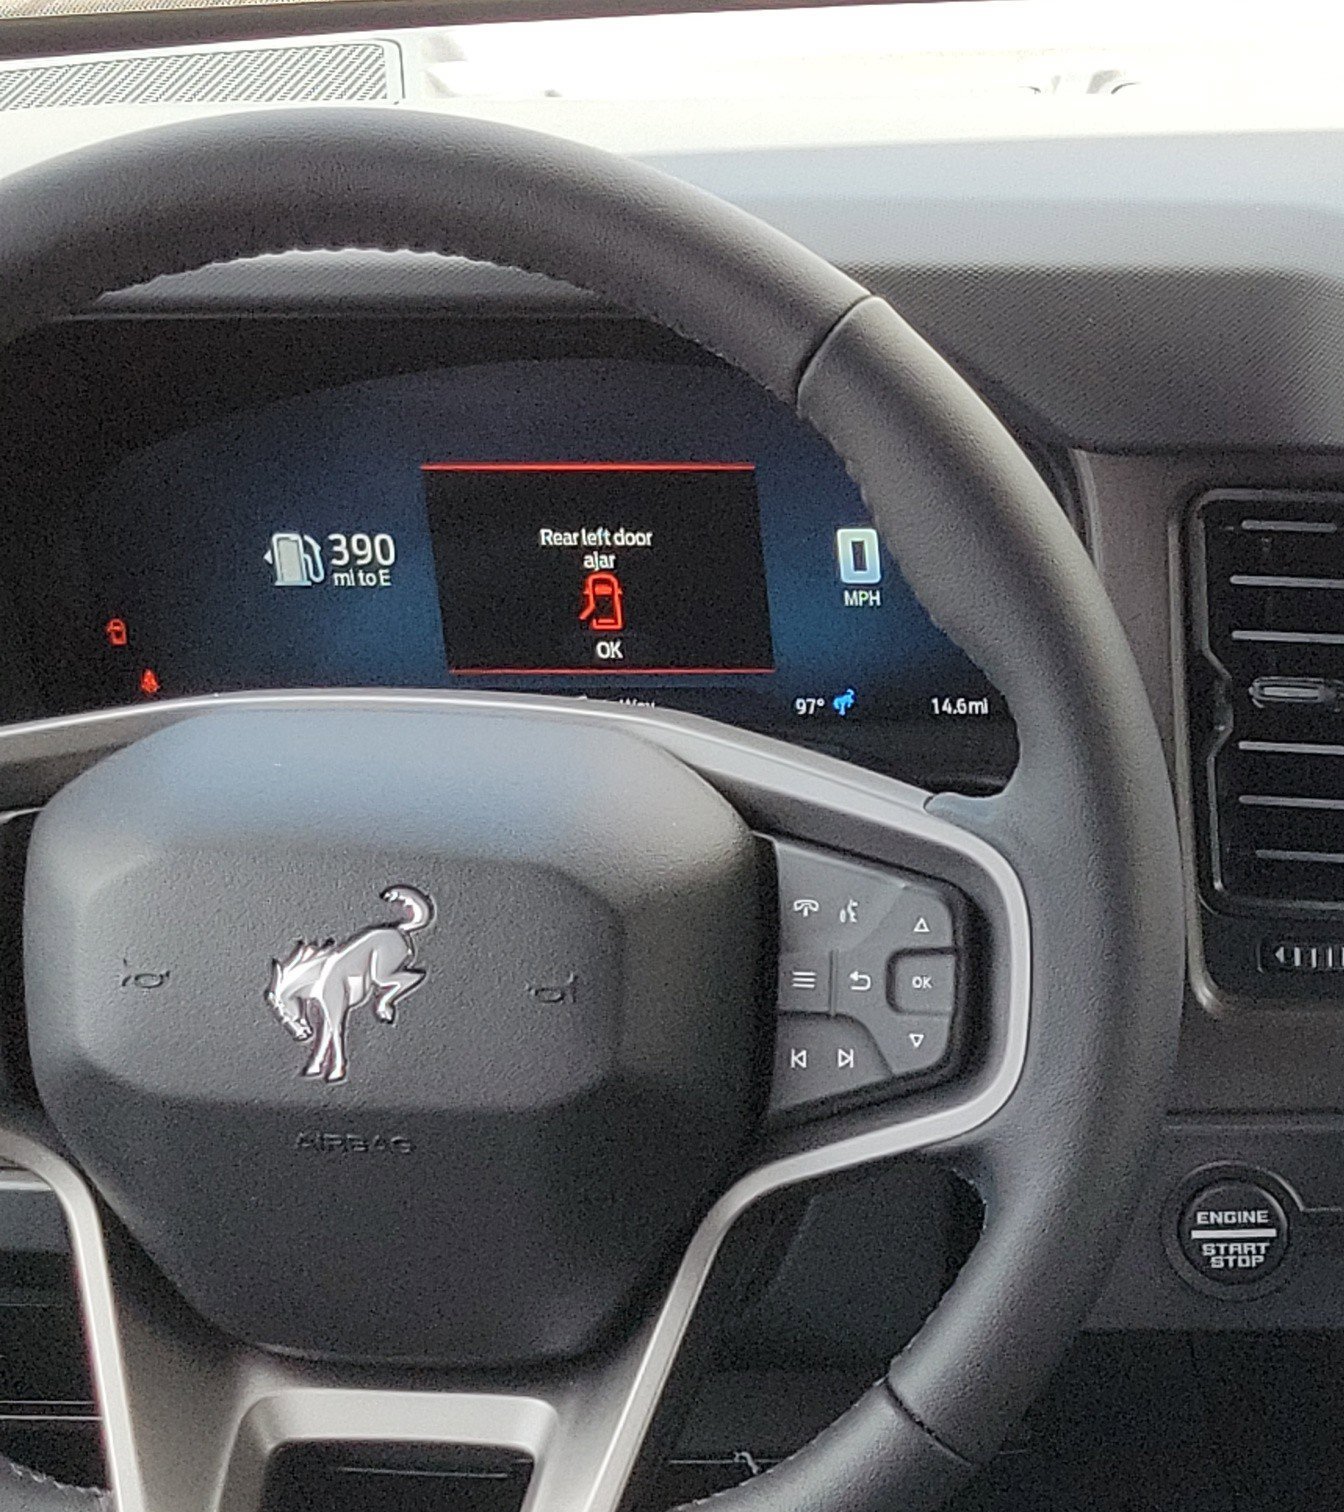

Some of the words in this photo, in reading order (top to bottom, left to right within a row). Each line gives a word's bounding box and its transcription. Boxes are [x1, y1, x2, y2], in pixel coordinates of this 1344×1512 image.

[540, 528, 579, 547] Rear
[581, 527, 611, 547] left
[613, 527, 653, 547] door
[328, 532, 396, 567] 390
[583, 552, 616, 571] ajar
[333, 569, 355, 586] mi
[357, 570, 376, 586] to
[379, 569, 391, 586] E
[844, 590, 881, 607] MPH
[596, 641, 624, 659] OK
[912, 976, 933, 990] OK
[294, 1132, 413, 1155] AIRBAG
[1196, 1209, 1270, 1225] ENGINE
[1202, 1242, 1270, 1256] START
[1210, 1254, 1265, 1269] STOP
